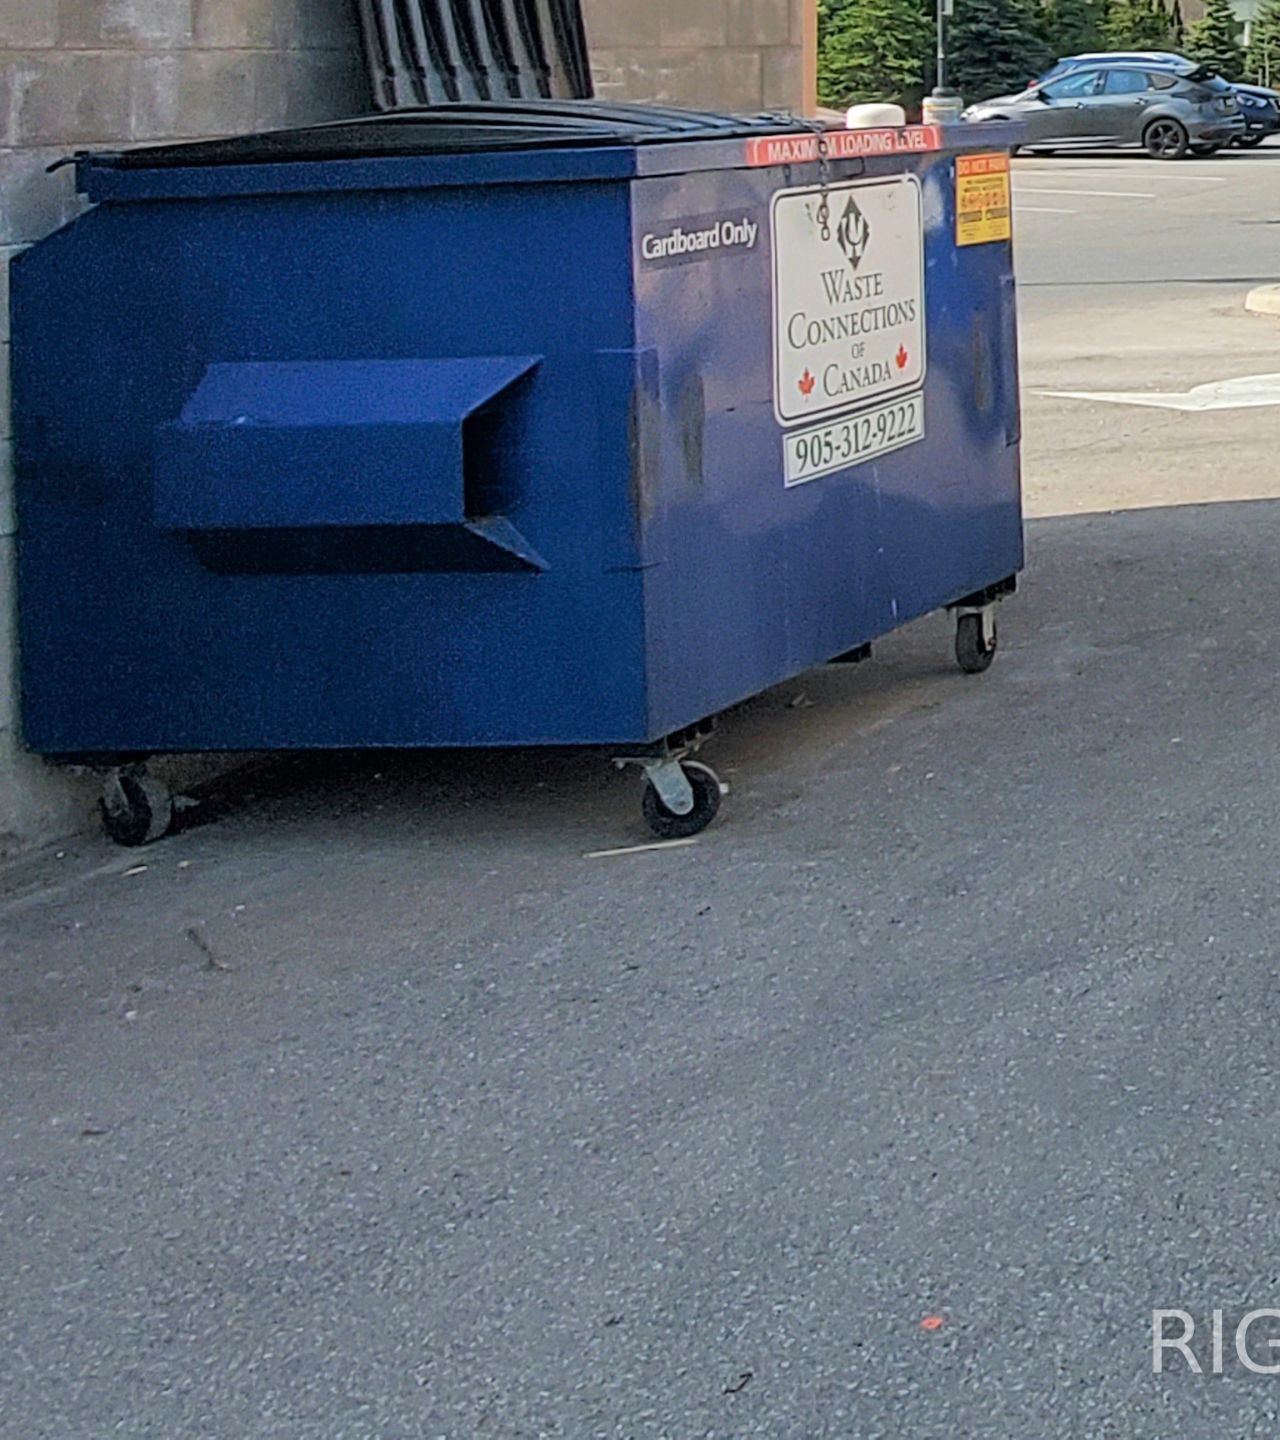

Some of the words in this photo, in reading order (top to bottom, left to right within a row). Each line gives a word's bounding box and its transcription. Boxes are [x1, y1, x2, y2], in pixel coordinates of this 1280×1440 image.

[841, 132, 892, 155] LOADING
[642, 221, 720, 260] Cardboard
[721, 217, 758, 248] Only
[821, 268, 884, 306] WASTE
[787, 298, 916, 350] CONNECTIONS
[851, 342, 866, 359] OF
[823, 359, 893, 398] CANADA
[795, 402, 917, 473] 905-312-9222
